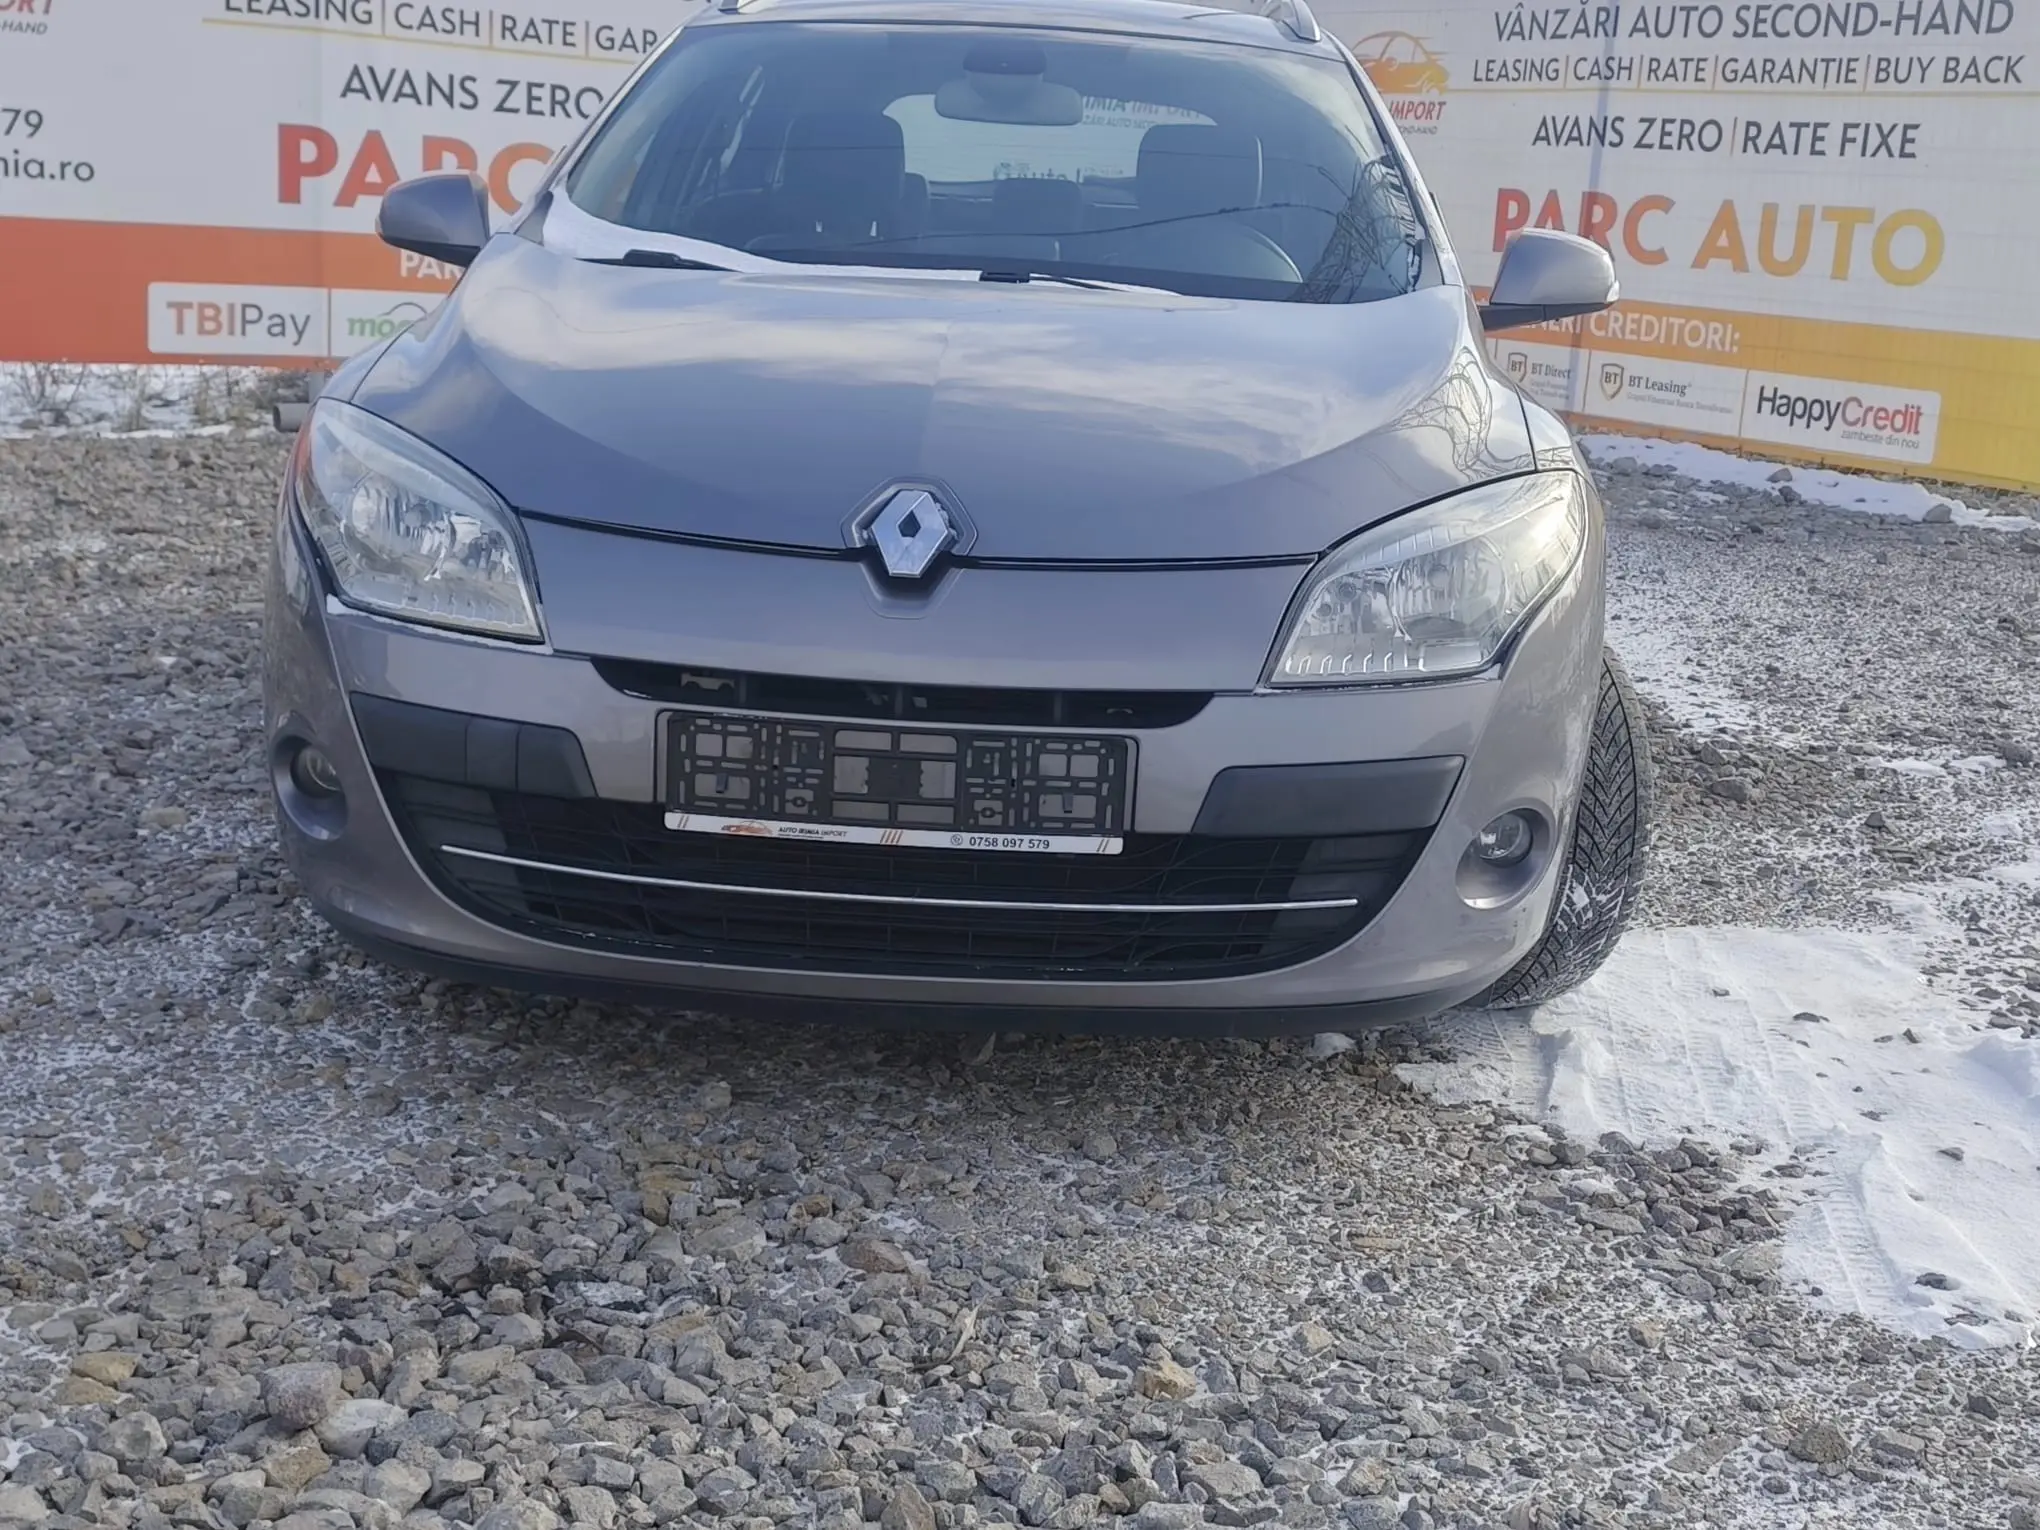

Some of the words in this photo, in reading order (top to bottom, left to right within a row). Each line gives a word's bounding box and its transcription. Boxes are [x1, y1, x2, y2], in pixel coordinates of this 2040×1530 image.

[394, 2, 480, 38] CASH
[501, 13, 577, 48] RATE
[1494, 0, 1621, 42] VÂNZĂRI
[1628, 4, 1724, 39] AUTO
[1732, 0, 2015, 39] SECOND-HAND
[1473, 57, 1560, 82] LEASING
[1573, 55, 1634, 82] CASH
[1646, 57, 1709, 83] RATE
[1874, 56, 1936, 84] BUY
[1942, 54, 2026, 84] BACK
[340, 63, 479, 111] AVANS
[493, 78, 604, 120] ZERO
[1, 107, 44, 138] 79
[1532, 114, 1625, 147] AVANS
[1633, 116, 1724, 152] ZERO
[1742, 120, 1830, 156] RATE
[1838, 122, 1922, 159] FIXE
[1492, 187, 1677, 266] PARC
[1690, 198, 1946, 287] AUTO
[166, 301, 311, 346] TBIPay
[1590, 308, 1741, 353] CREDITORI:
[1511, 359, 1523, 373] BT
[1531, 362, 1543, 376] BT
[1544, 364, 1571, 380] Direct
[1604, 371, 1619, 385] BT
[1628, 374, 1643, 389] BT
[1756, 384, 1924, 436] HappyCredit
[778, 826, 798, 834] AUTO
[969, 836, 999, 848] 0758
[1002, 838, 1024, 849] 097
[1027, 839, 1050, 849] 579
